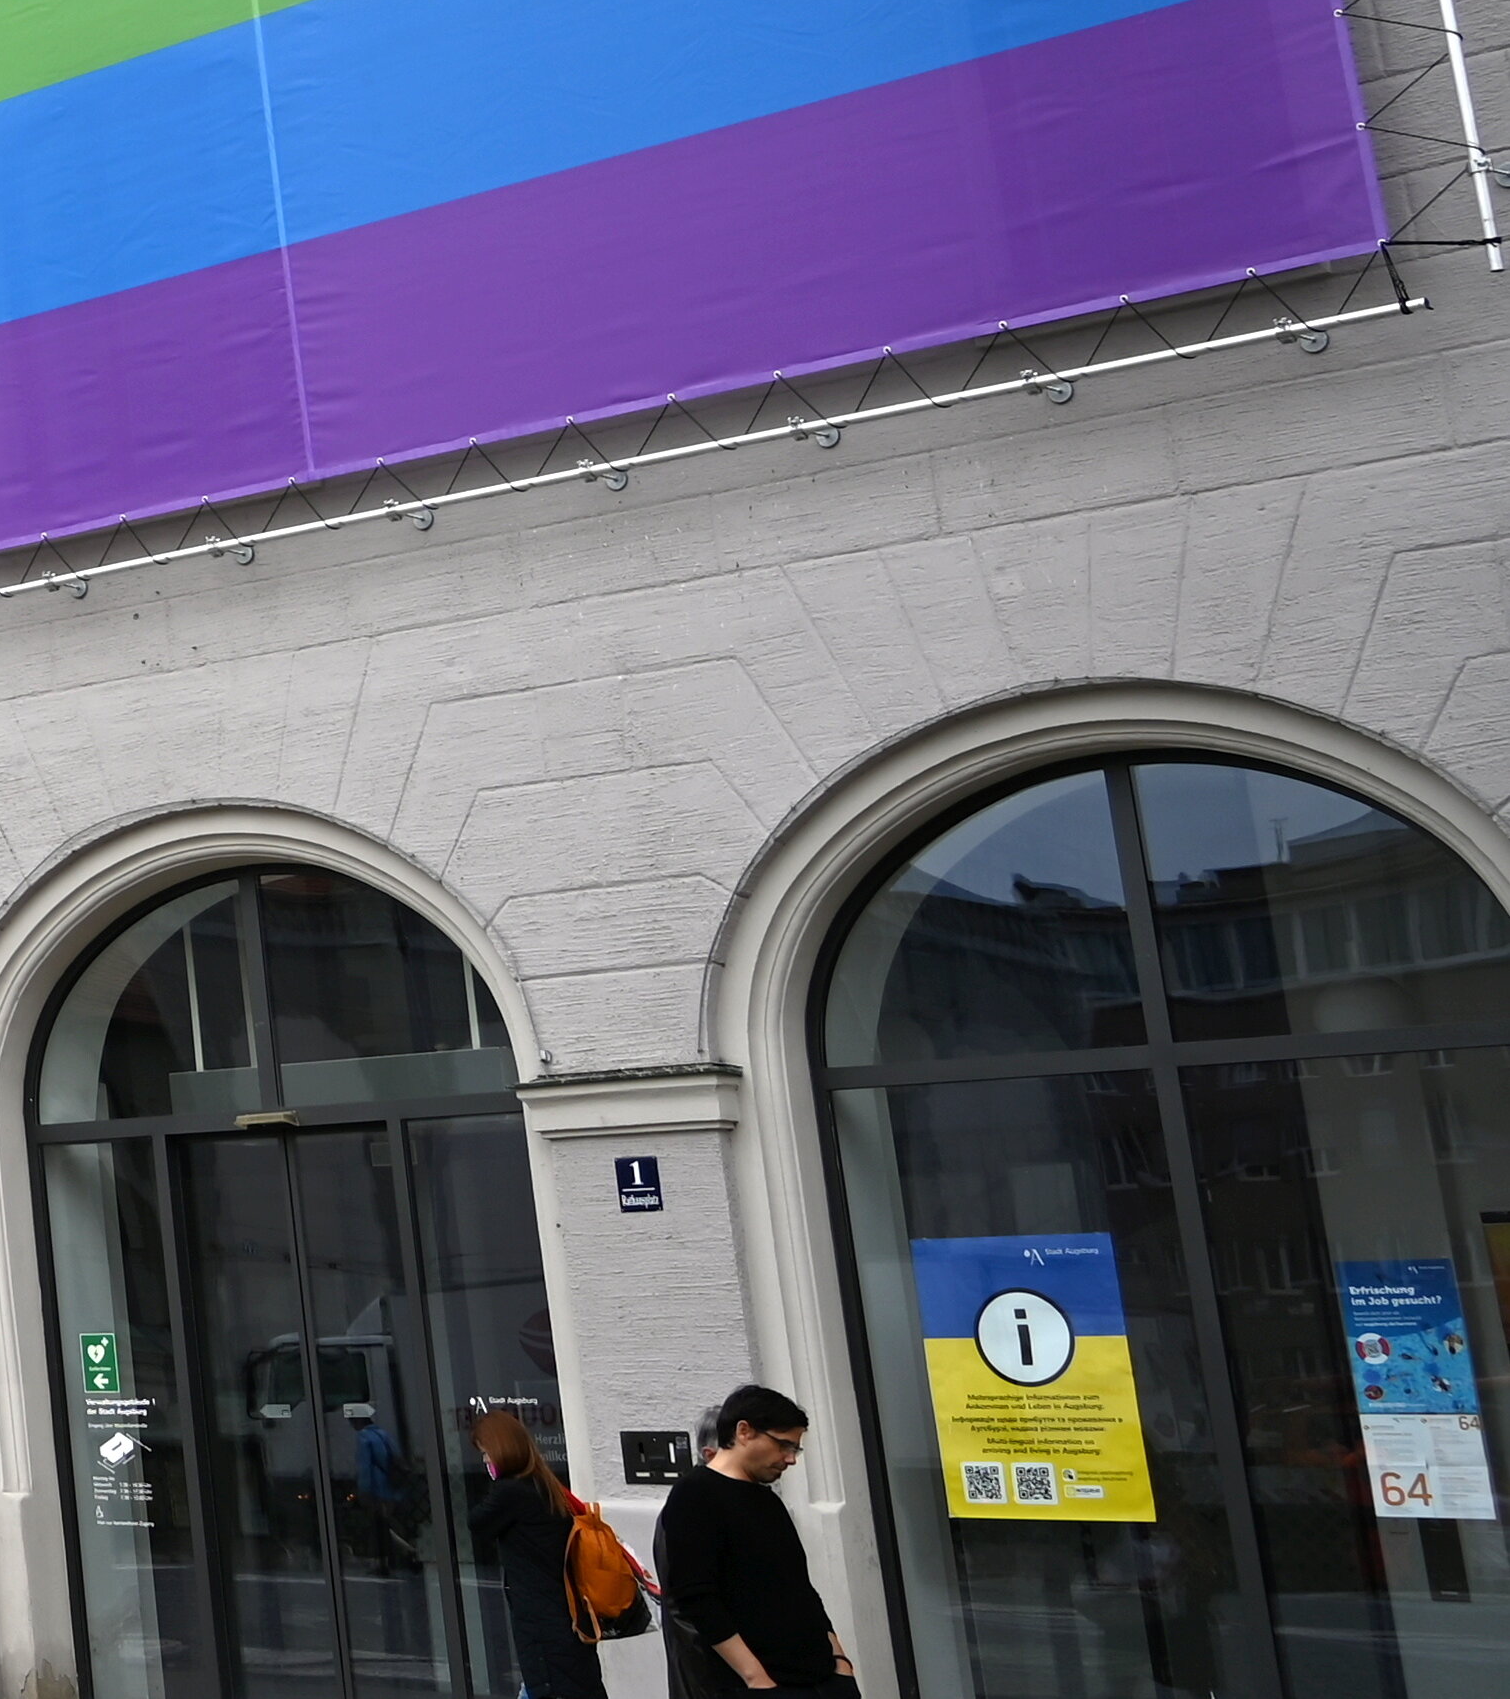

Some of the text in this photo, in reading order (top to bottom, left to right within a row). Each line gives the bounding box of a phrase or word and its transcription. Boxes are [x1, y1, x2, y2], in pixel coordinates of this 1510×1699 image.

[629, 1160, 644, 1186] 1
[1349, 1285, 1415, 1297] Erfrischung
[1351, 1295, 1442, 1308] im Job gesucht?
[1459, 1415, 1481, 1431] 64
[1380, 1472, 1433, 1507] 64
